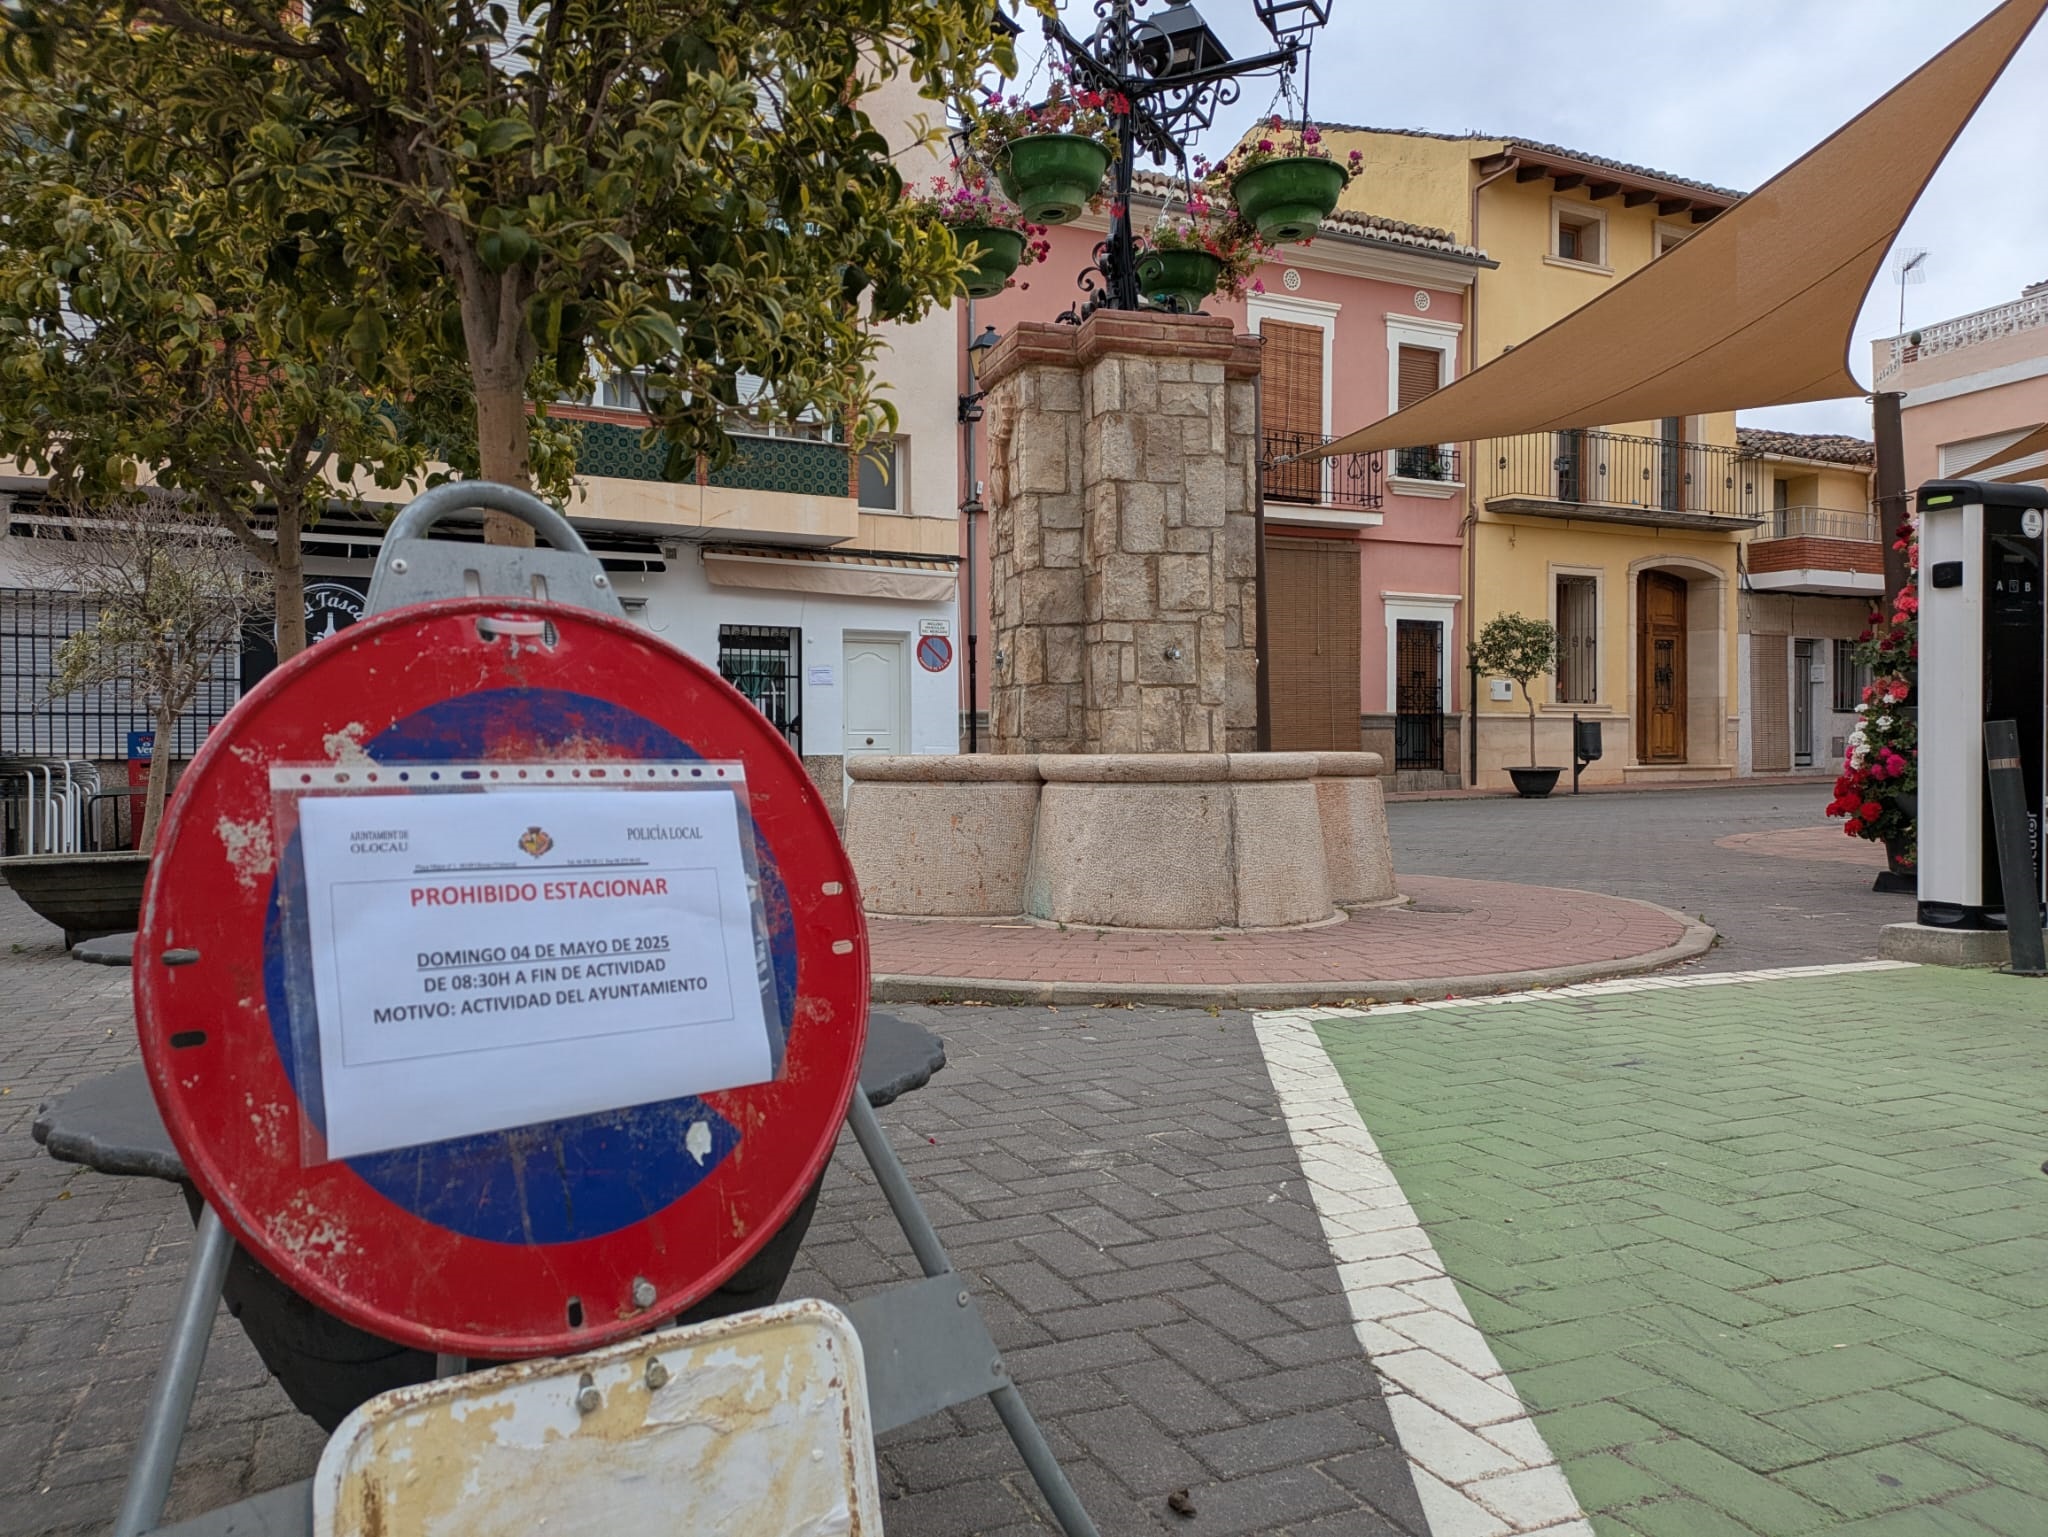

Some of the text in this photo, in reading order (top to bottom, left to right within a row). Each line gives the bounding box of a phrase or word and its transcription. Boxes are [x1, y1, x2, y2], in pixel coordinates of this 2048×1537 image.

[1996, 580, 2031, 592] A B
[315, 591, 364, 622] Tasca
[136, 746, 154, 754] Ver
[350, 831, 397, 841] AJUNTAMENT
[627, 824, 703, 840] POLICÍA LOCAL
[350, 842, 408, 853] OLOCAU
[410, 878, 668, 907] PROHIBIDO ESTACIONAR
[417, 935, 669, 968] DOMINGO 04 DE MAYO DE 2025
[424, 958, 666, 993] DE 08:30H A FIN DE ACTIVIDAD
[373, 976, 708, 1024] MOTIVO: ACTIVIDAD DEL AYUNTAMIENTO
